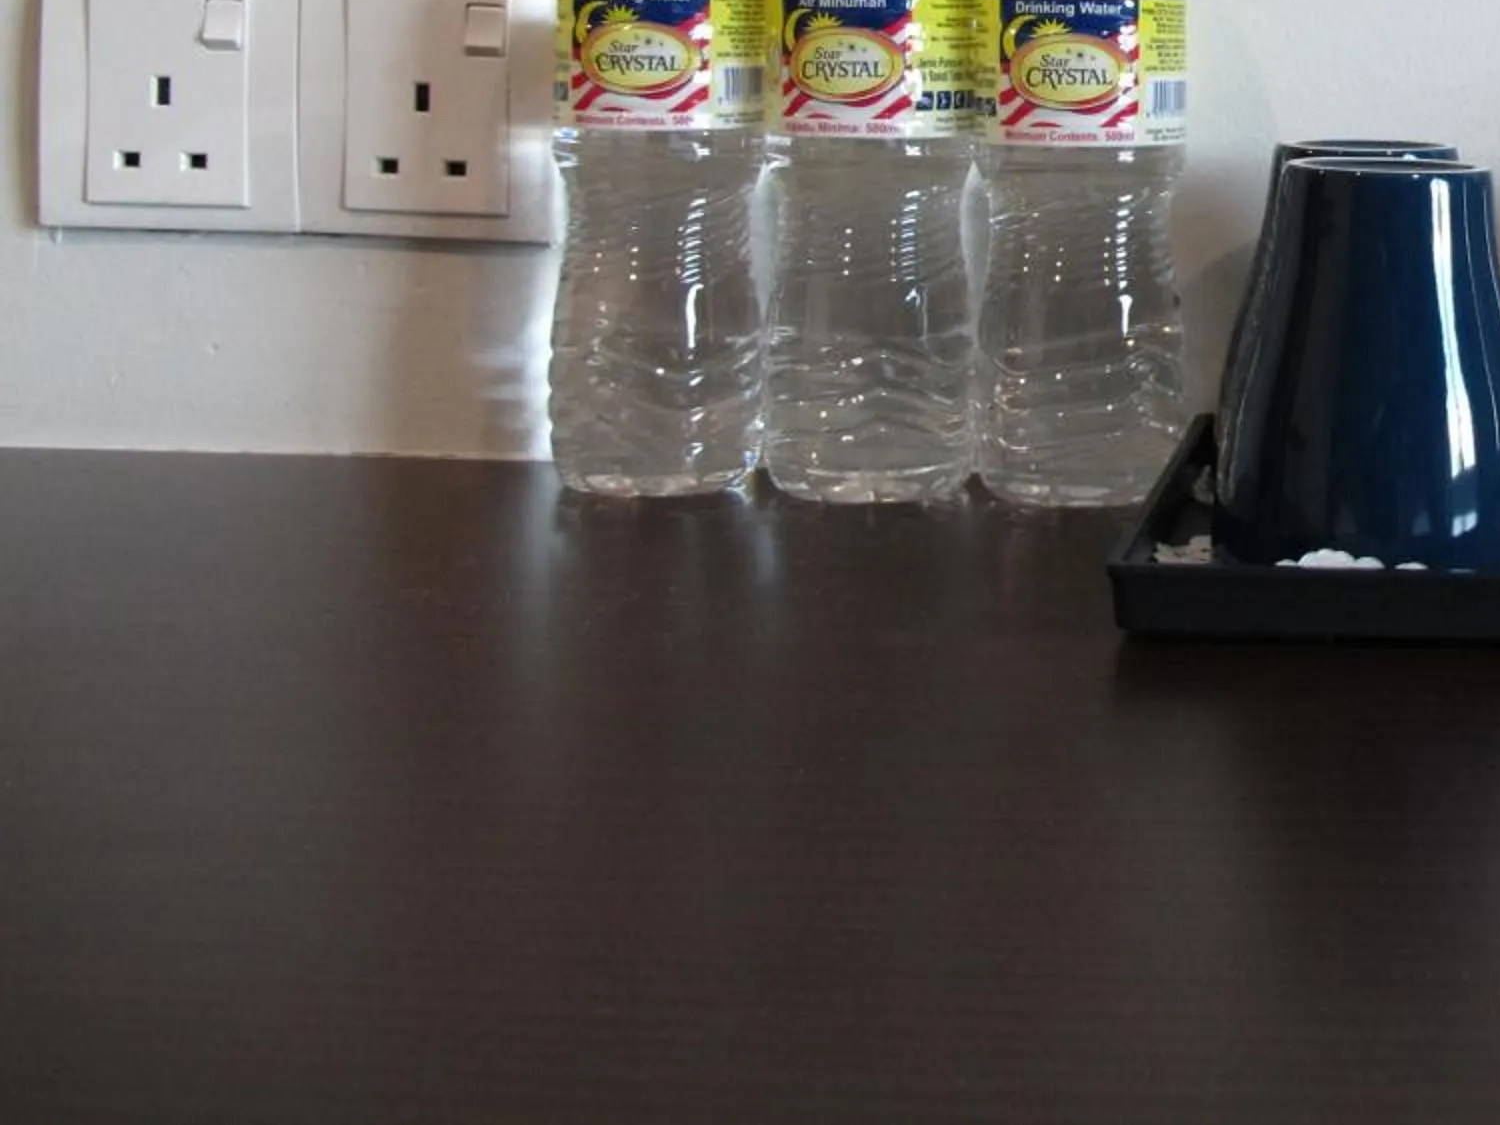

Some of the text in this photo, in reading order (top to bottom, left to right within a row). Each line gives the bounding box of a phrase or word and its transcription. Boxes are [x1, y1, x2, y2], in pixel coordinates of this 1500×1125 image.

[1015, 1, 1123, 16] Drinking Water
[609, 39, 639, 54] Star
[815, 46, 842, 60] Star
[594, 53, 678, 75] CRYSTAL
[1040, 54, 1071, 68] Star
[802, 60, 884, 83] CRYSTAL
[1026, 66, 1113, 90] CRYSTAL
